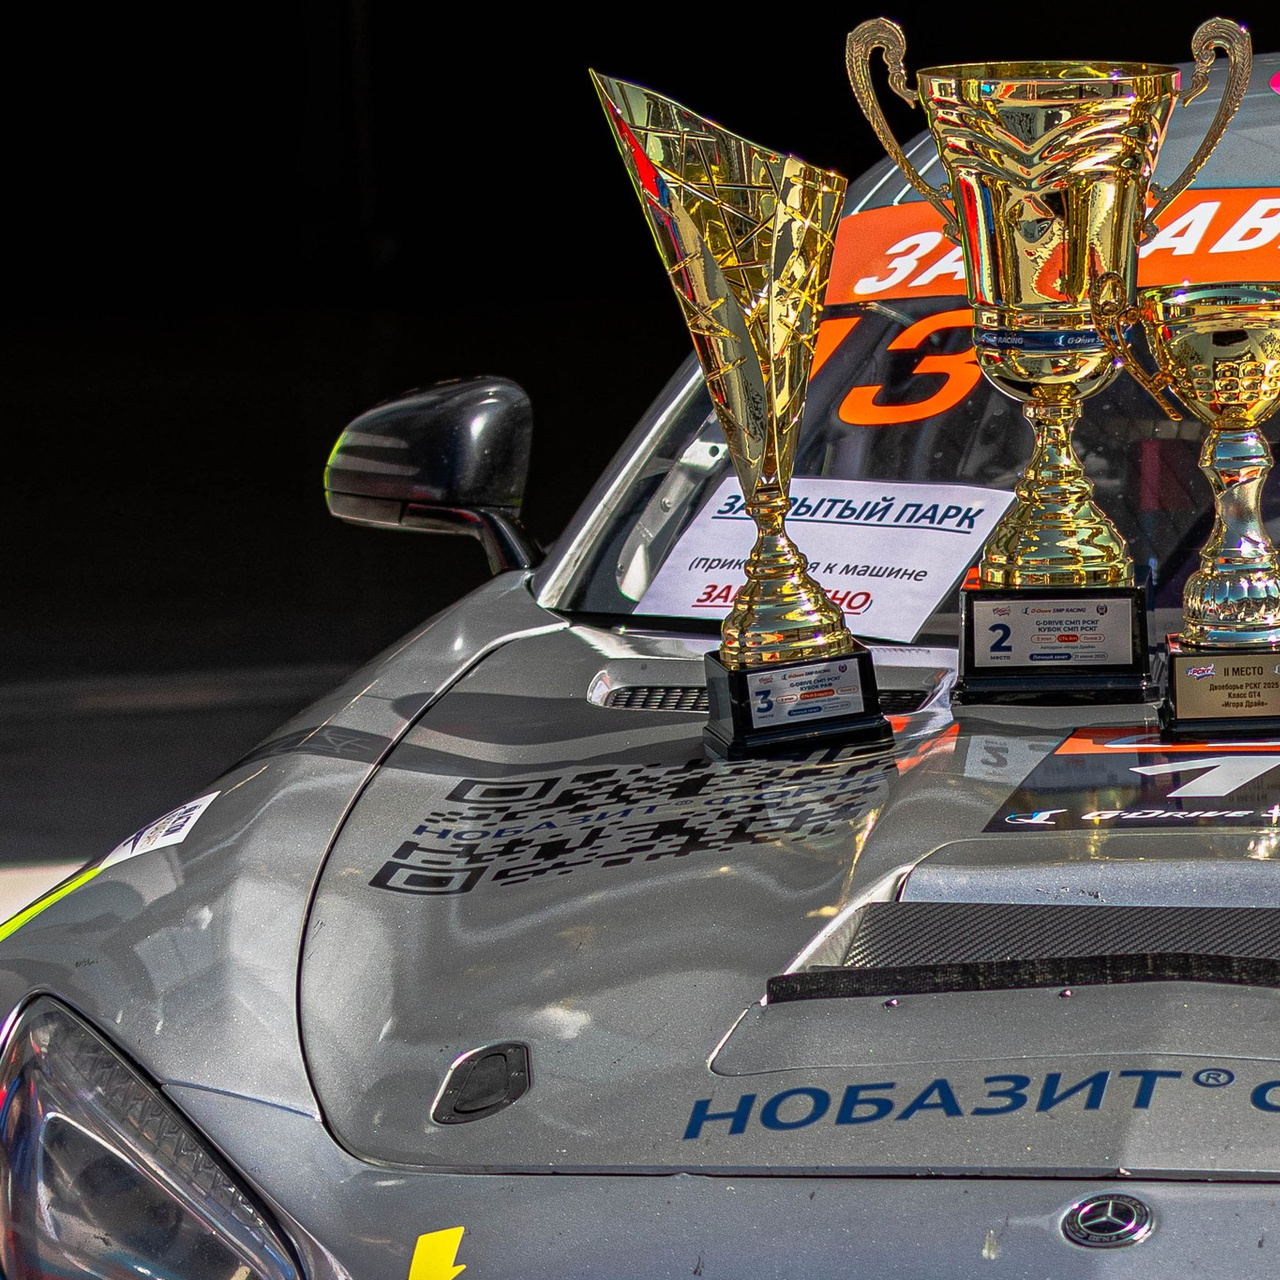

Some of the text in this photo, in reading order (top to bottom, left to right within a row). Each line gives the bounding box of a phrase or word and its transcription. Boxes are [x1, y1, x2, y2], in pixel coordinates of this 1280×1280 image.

[894, 502, 984, 530] ПАРК
[840, 563, 927, 582] машине
[989, 623, 1012, 652] 2
[1232, 667, 1263, 676] МЕСТО
[755, 690, 773, 713] 3
